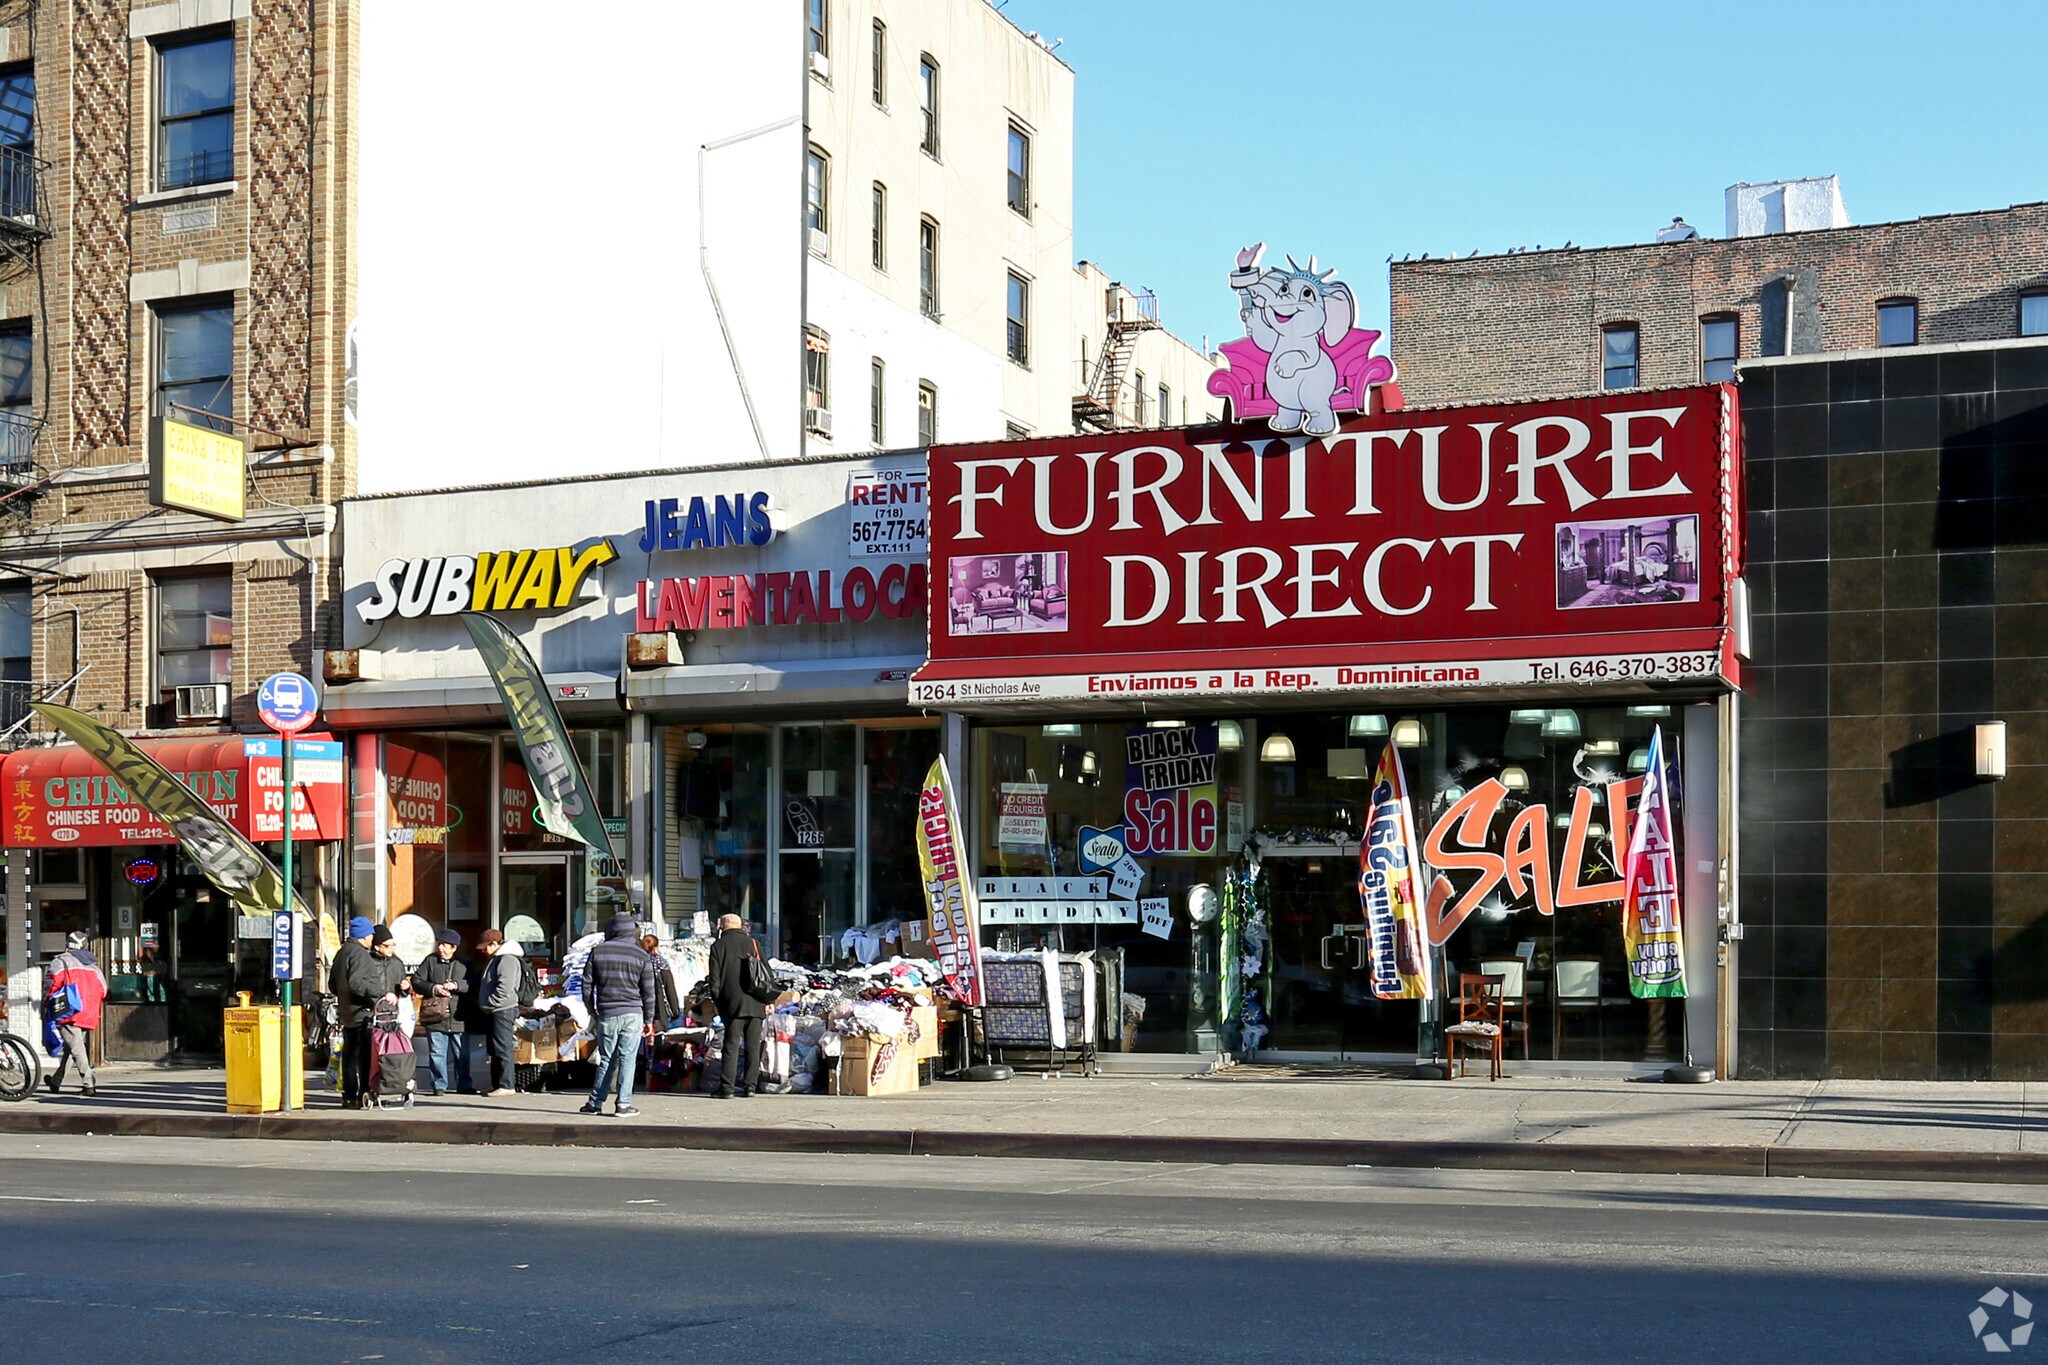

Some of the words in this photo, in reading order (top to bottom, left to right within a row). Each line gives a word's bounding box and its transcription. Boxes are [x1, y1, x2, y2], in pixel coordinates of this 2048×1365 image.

[876, 470, 903, 481] FOR
[947, 405, 1692, 541] FURNITURE
[852, 481, 927, 506] RENT
[639, 491, 774, 553] JEANS
[875, 506, 904, 520] (718)
[852, 519, 926, 543] 567-7754
[866, 542, 912, 554] EXT.111
[356, 538, 619, 625] SUBWAY
[1103, 532, 1525, 630] DIRECT
[1528, 662, 1565, 680] Tel.
[1569, 654, 1719, 678] 646-370-3837
[1088, 672, 1197, 693] Enviamos
[1208, 675, 1222, 689] a
[1233, 671, 1254, 688] la
[1265, 669, 1318, 692] Rep.
[1337, 665, 1480, 687] Dominicana
[914, 684, 956, 700] 1264
[961, 684, 972, 695] St
[974, 682, 1019, 695] Nicholas
[1021, 682, 1040, 693] Ave
[275, 713, 312, 730] STANDING
[245, 741, 267, 755] M3
[1126, 726, 1199, 764] BLACK
[1142, 754, 1216, 792] FRIDAY
[44, 775, 139, 807] CHIN
[264, 790, 306, 812] FOD
[1003, 805, 1044, 814] REQUIRED
[1017, 796, 1044, 805] CREDIT
[13, 779, 37, 843] 東方紅
[46, 810, 100, 826] CHINESE
[105, 807, 141, 824] FOOD
[788, 801, 815, 832] OPE
[1124, 787, 1217, 853] Sale
[387, 826, 447, 844] SUBWAY
[605, 822, 627, 832] SPECIA
[799, 831, 824, 844] 1266
[1088, 841, 1119, 860] Sealy
[1123, 860, 1138, 878] 20%
[1117, 878, 1136, 889] OFF
[1143, 901, 1166, 911] 20%
[122, 911, 129, 923] B
[1147, 914, 1170, 928] OFF
[142, 925, 158, 935] OPEN
[277, 932, 290, 940] Bus
[276, 941, 290, 949] Stop
